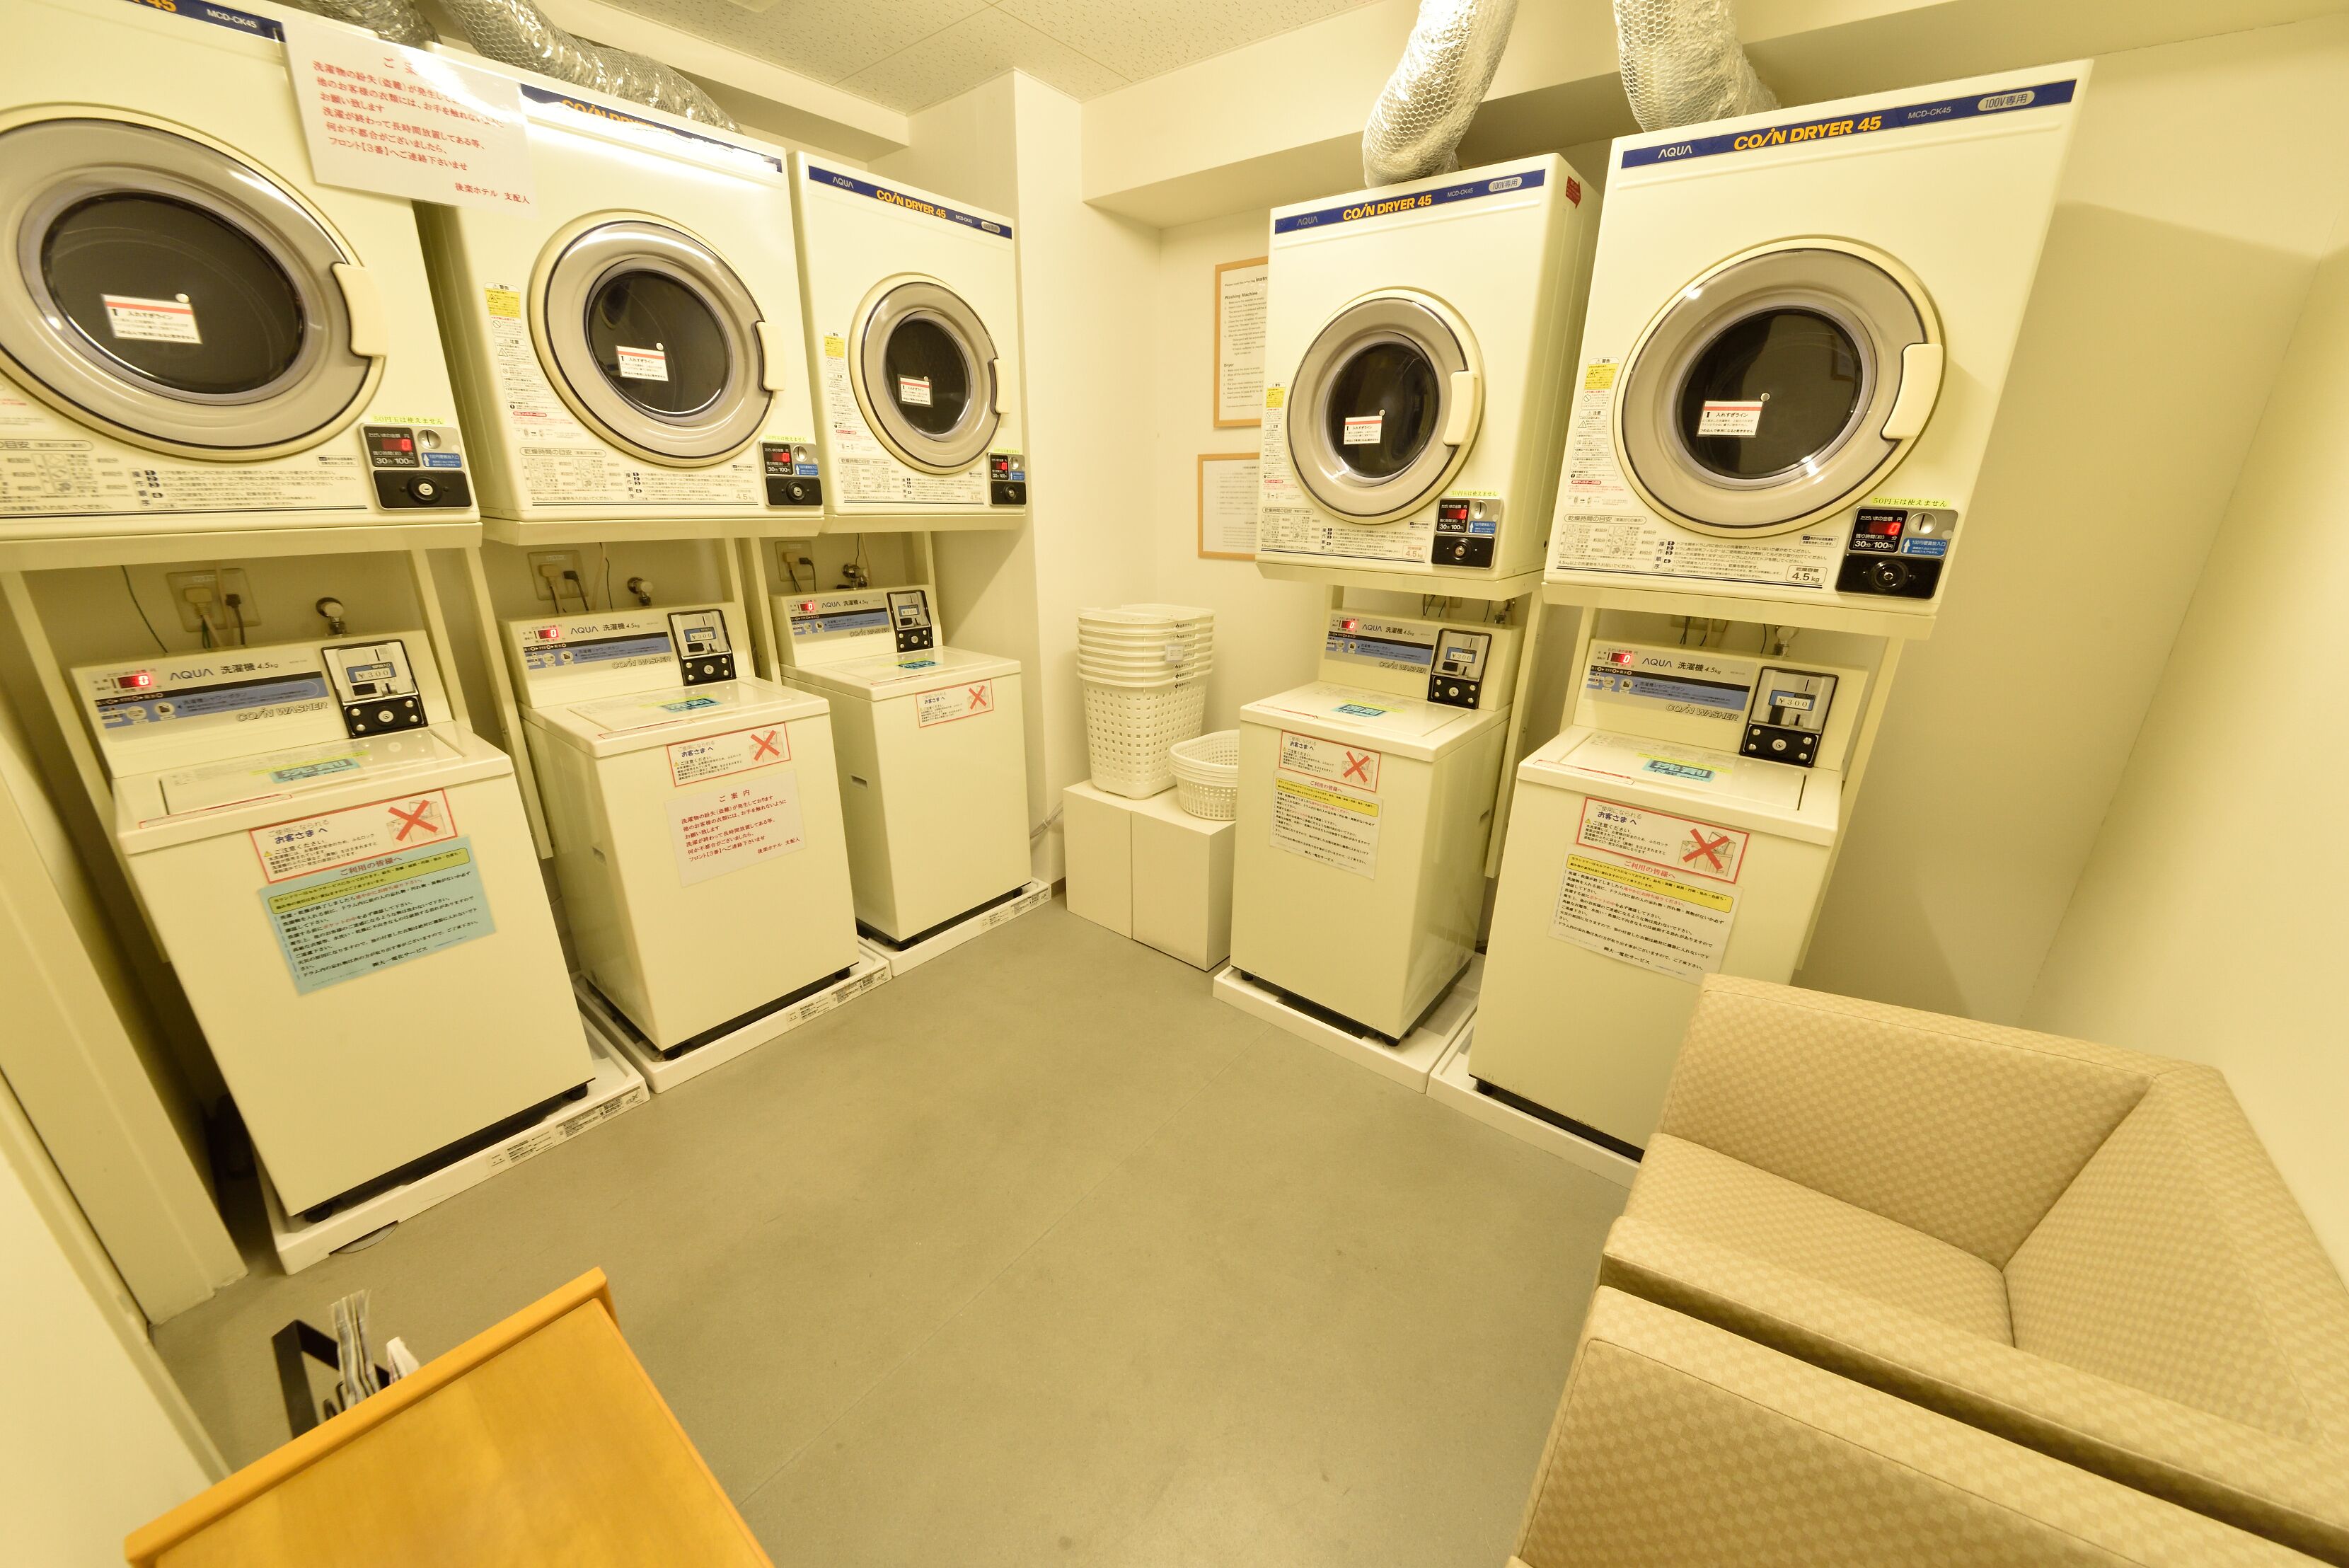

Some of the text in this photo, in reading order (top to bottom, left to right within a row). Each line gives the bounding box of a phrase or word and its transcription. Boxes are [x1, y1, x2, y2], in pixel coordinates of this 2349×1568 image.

[1983, 93, 2028, 110] 100V専用
[1907, 105, 1952, 120] MCD-CK45
[1789, 120, 1854, 143] DRYER
[1857, 115, 1882, 132] 45
[1657, 145, 1693, 158] AQUA
[832, 176, 855, 189] AQUA
[1491, 178, 1519, 190] 100V専用
[503, 192, 531, 204] 支配人
[1447, 187, 1474, 198] MCD-CK45
[905, 198, 935, 215] DRYER
[935, 208, 947, 219] 45
[1377, 197, 1416, 215] DRYER
[1417, 194, 1432, 207] 45
[1296, 216, 1318, 227] AQUA
[1873, 497, 1948, 507] 50円玉は使えません
[1791, 572, 1810, 581] 4.5
[570, 626, 599, 635] AQUA
[602, 623, 625, 631] 洗濯機
[1361, 624, 1383, 633] AQUA
[1385, 626, 1403, 635] 洗濯機
[637, 655, 671, 666] WASHER
[1623, 655, 1631, 663] 0
[1641, 657, 1673, 668] AQUA
[220, 662, 256, 675] 洗濯機
[1399, 664, 1428, 674] WASHER
[1677, 662, 1704, 672] 洗濯機
[170, 668, 214, 681] AQUA
[1778, 697, 1808, 708] ¥300
[277, 701, 329, 717] WASHER
[1697, 708, 1739, 722] WASHER
[785, 837, 801, 847] 支配人
[340, 856, 403, 877] ご利用の皆様へ
[1624, 860, 1676, 880] ご利用の皆様へ
